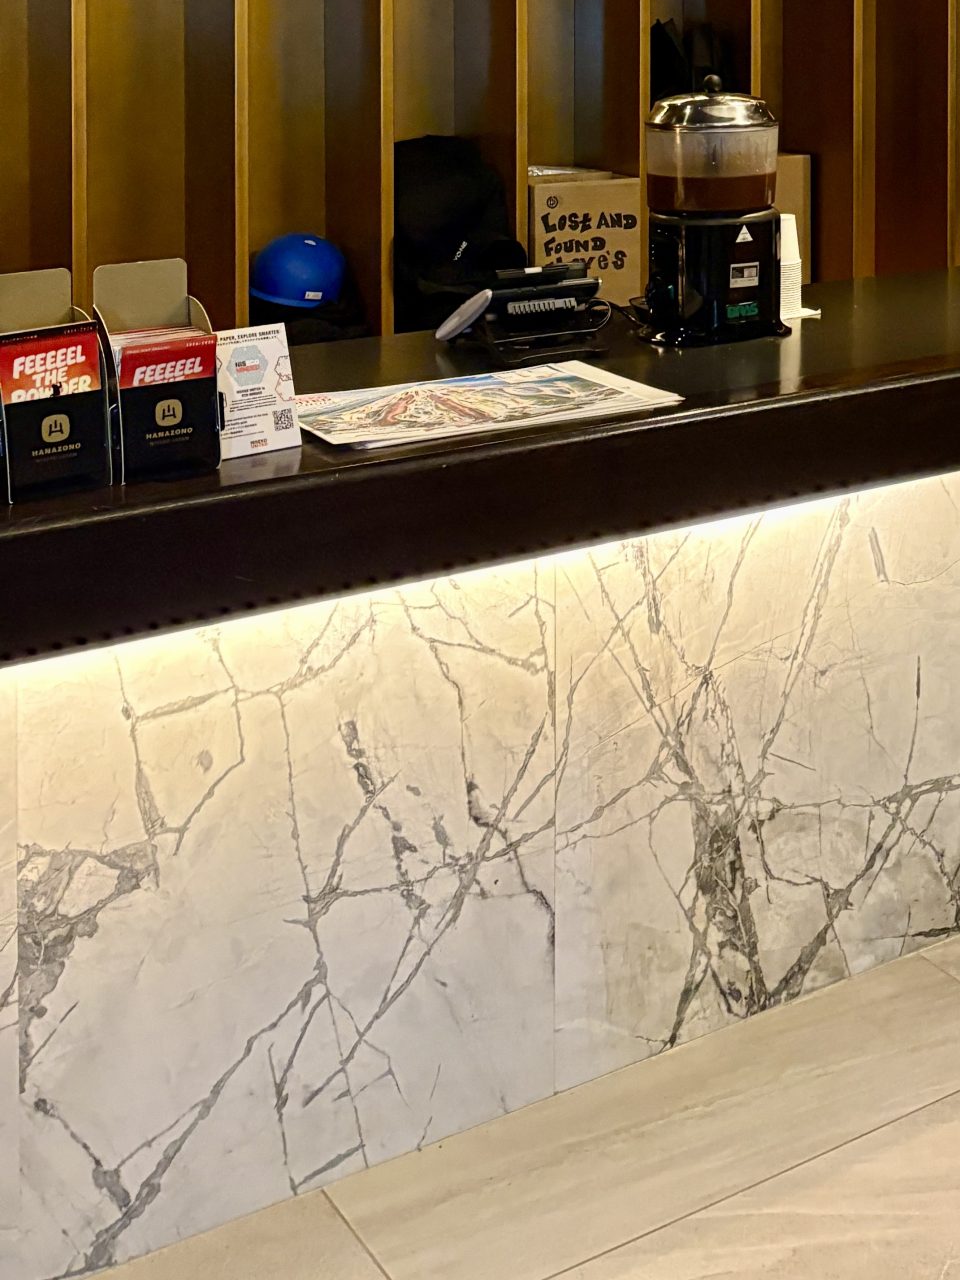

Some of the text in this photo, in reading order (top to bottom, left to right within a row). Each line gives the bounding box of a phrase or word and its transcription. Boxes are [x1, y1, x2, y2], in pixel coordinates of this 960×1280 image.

[596, 211, 638, 230] AND
[237, 332, 257, 340] EXPLORE
[258, 329, 280, 337] SMARTER
[12, 345, 86, 380] FEEEEEL
[132, 356, 204, 387] FEEEEEL
[32, 367, 68, 388] THE
[146, 427, 193, 440] HANAZONO
[31, 442, 81, 457] HANAZONO
